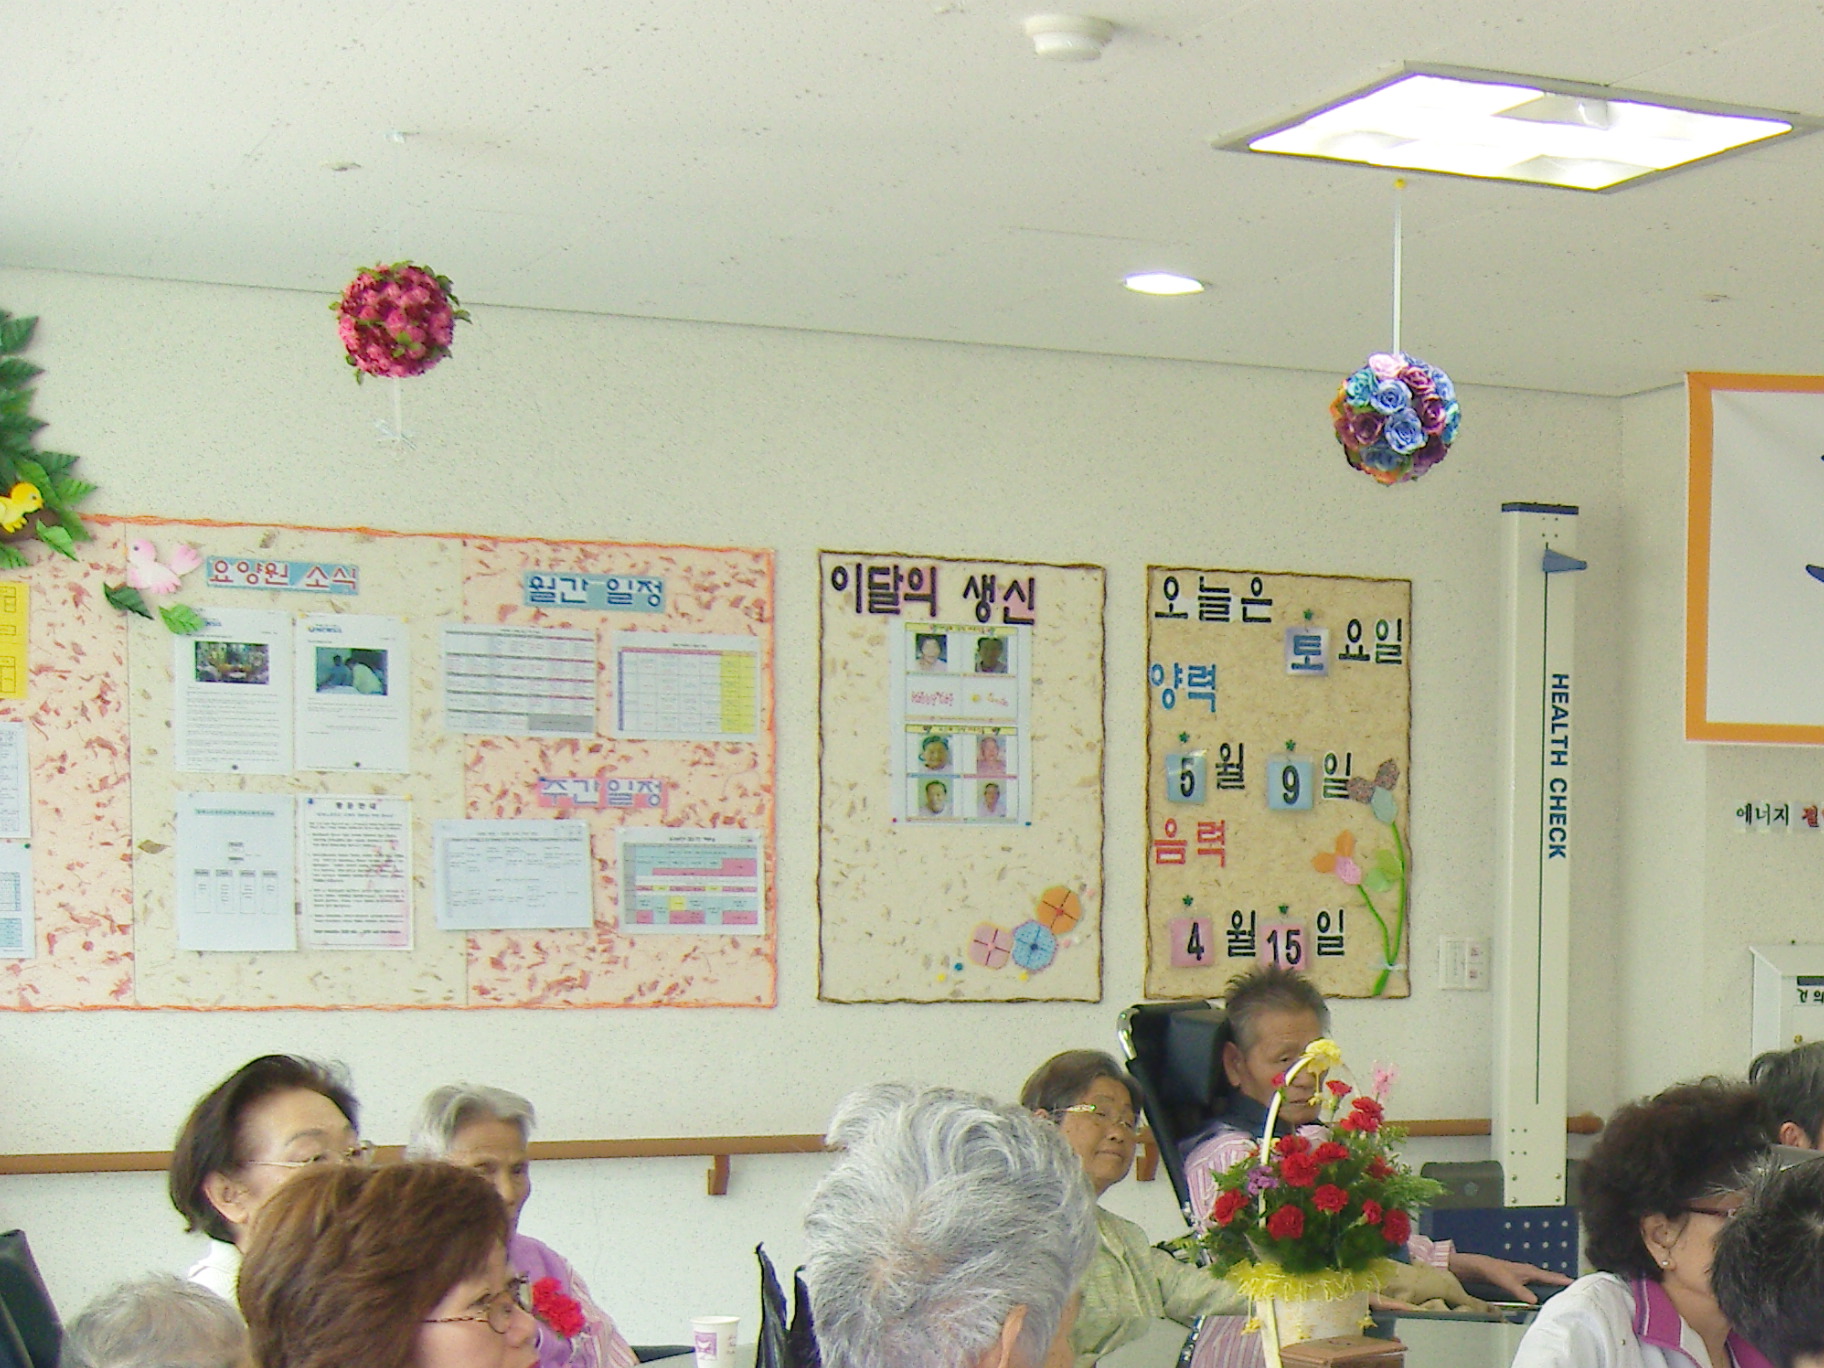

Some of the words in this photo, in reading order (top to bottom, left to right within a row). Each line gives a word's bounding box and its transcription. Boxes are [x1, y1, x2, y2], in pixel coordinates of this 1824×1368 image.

[208, 559, 290, 588] 요양원
[305, 564, 359, 591] 소식
[528, 575, 590, 605] 월간
[606, 577, 662, 607] 일정
[830, 562, 938, 618] 이달의
[962, 573, 1036, 626] 생신
[1154, 575, 1273, 623] 오늘은
[1291, 635, 1324, 671] 토
[1338, 617, 1402, 665] 요일
[1150, 661, 1217, 713] 양력
[1550, 673, 1570, 766] HEALTH
[541, 779, 599, 805] 주간
[606, 779, 662, 807] 일정
[1180, 757, 1196, 798] 5
[1215, 742, 1246, 790] 월
[1282, 764, 1300, 806] 9
[1323, 752, 1352, 799] 일
[1548, 777, 1568, 859] CHECK
[1736, 803, 1790, 826] 에너지
[1153, 817, 1227, 869] 음력
[1186, 922, 1205, 962] 4
[1226, 909, 1257, 958] 월
[1266, 929, 1302, 970] 15
[1316, 908, 1345, 957] 일
